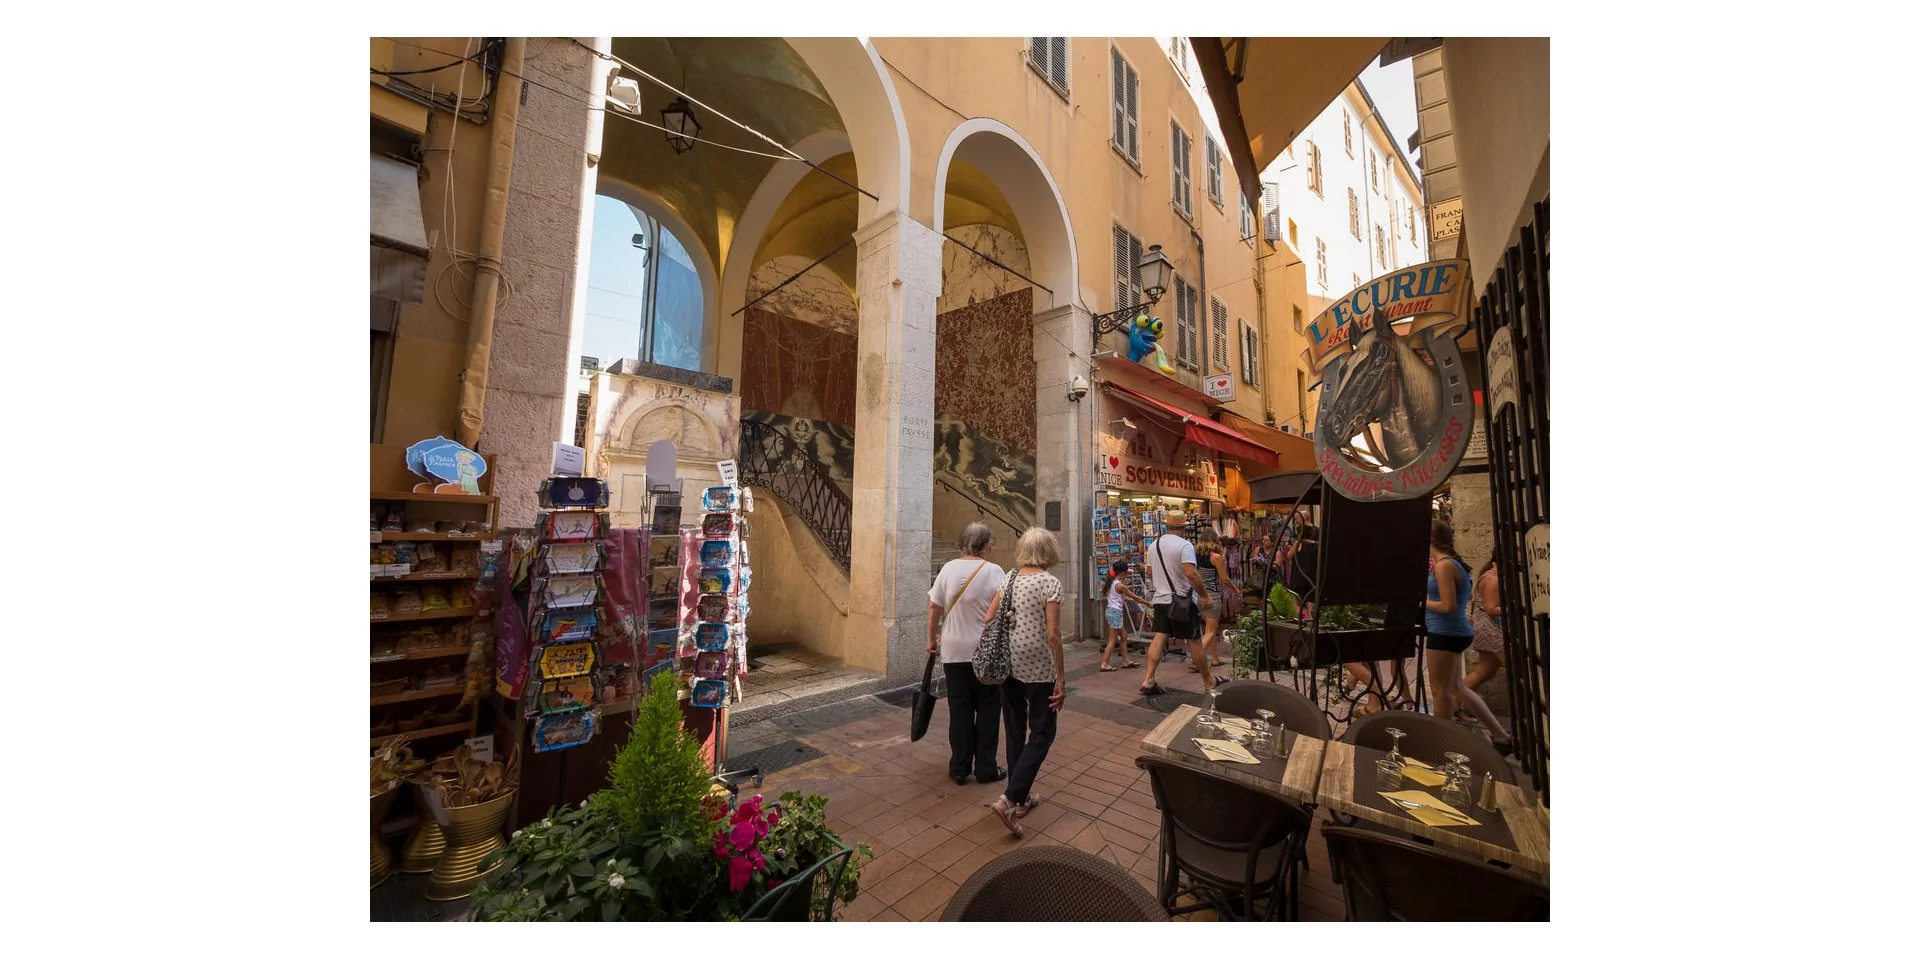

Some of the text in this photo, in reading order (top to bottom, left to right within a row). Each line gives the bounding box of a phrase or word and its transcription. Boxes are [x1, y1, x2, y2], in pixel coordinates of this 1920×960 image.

[1435, 209, 1463, 220] FRAN
[1446, 219, 1460, 227] CA
[1436, 227, 1460, 238] PLAS
[1308, 264, 1459, 345] L'ECURIE
[1328, 297, 1433, 349] Resturant
[1210, 388, 1230, 397] NICE
[903, 415, 928, 428] PORTE
[1102, 454, 1107, 470] I
[1100, 471, 1123, 486] NICE
[1125, 464, 1204, 493] SOUVENIRS
